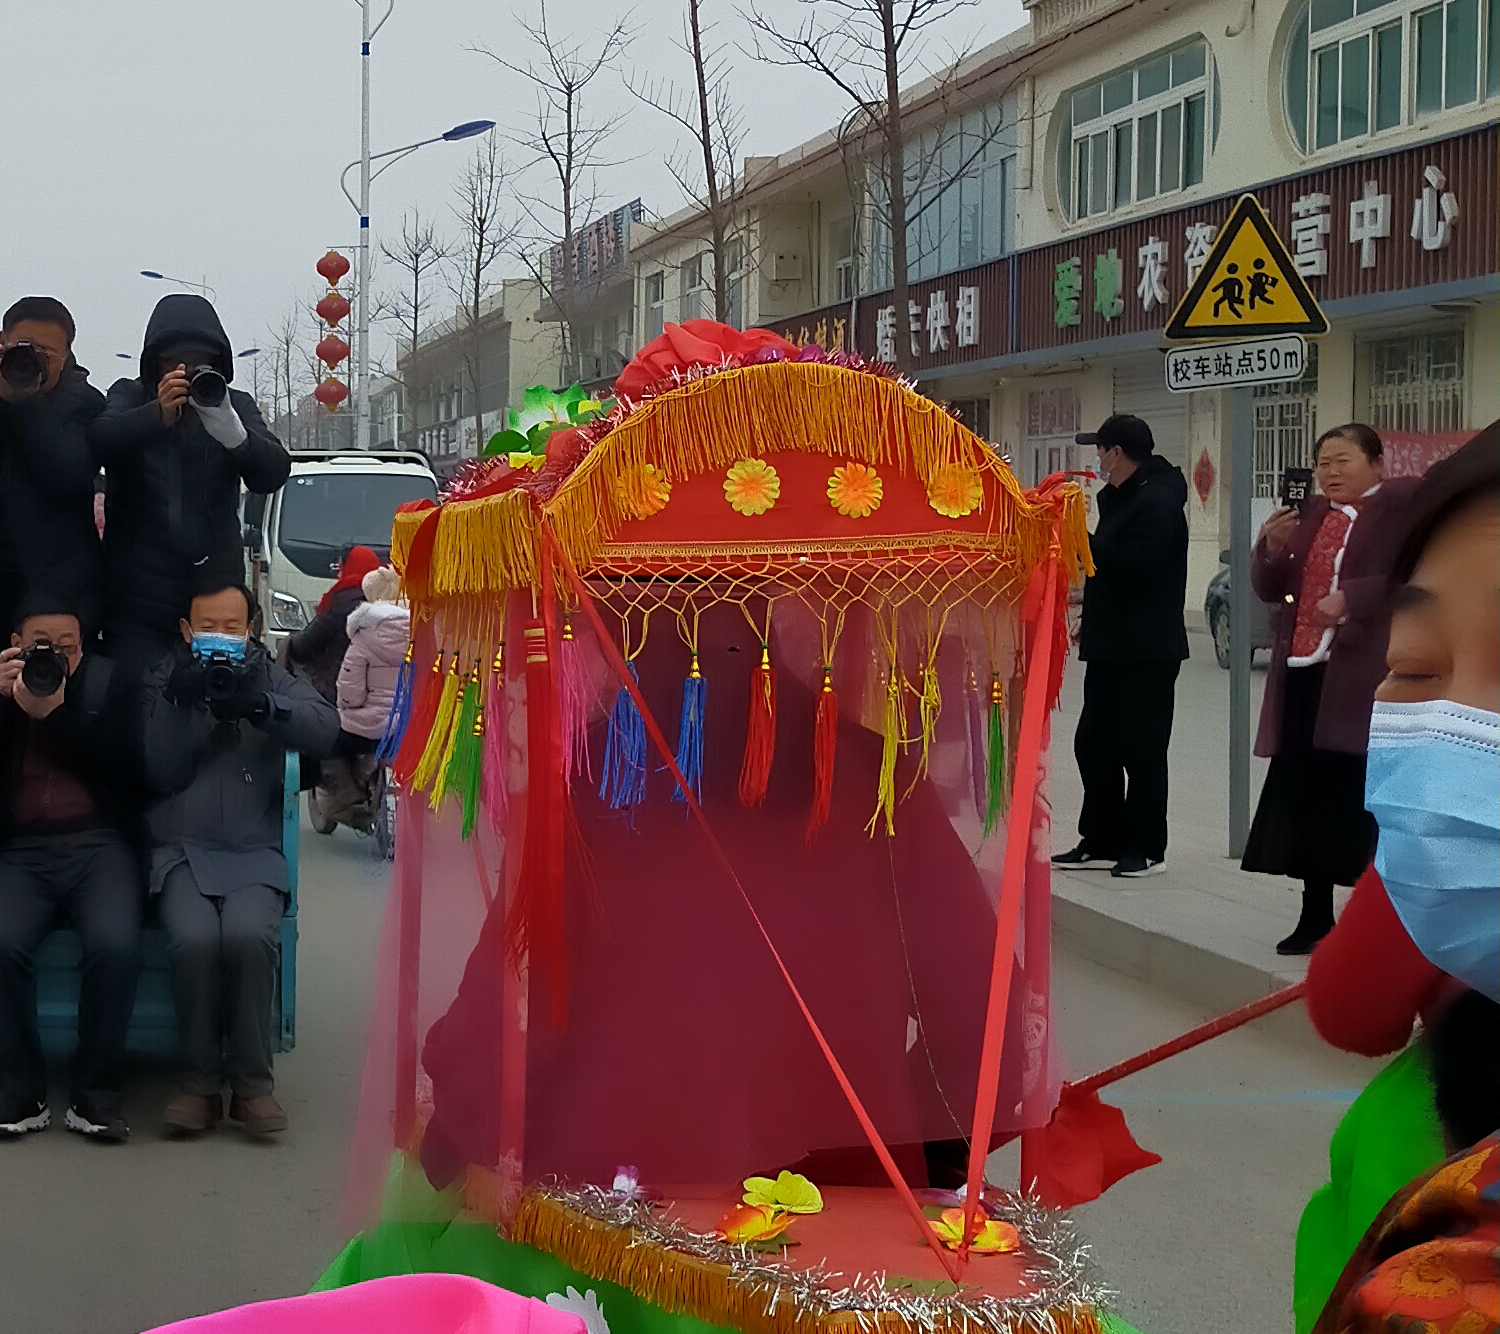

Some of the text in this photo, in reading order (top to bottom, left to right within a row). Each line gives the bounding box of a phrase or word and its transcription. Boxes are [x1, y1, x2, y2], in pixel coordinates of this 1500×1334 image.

[1054, 165, 1460, 329] 爱地农资营中心
[1172, 347, 1299, 383] 校车站点50m
[1289, 487, 1305, 500] 23
